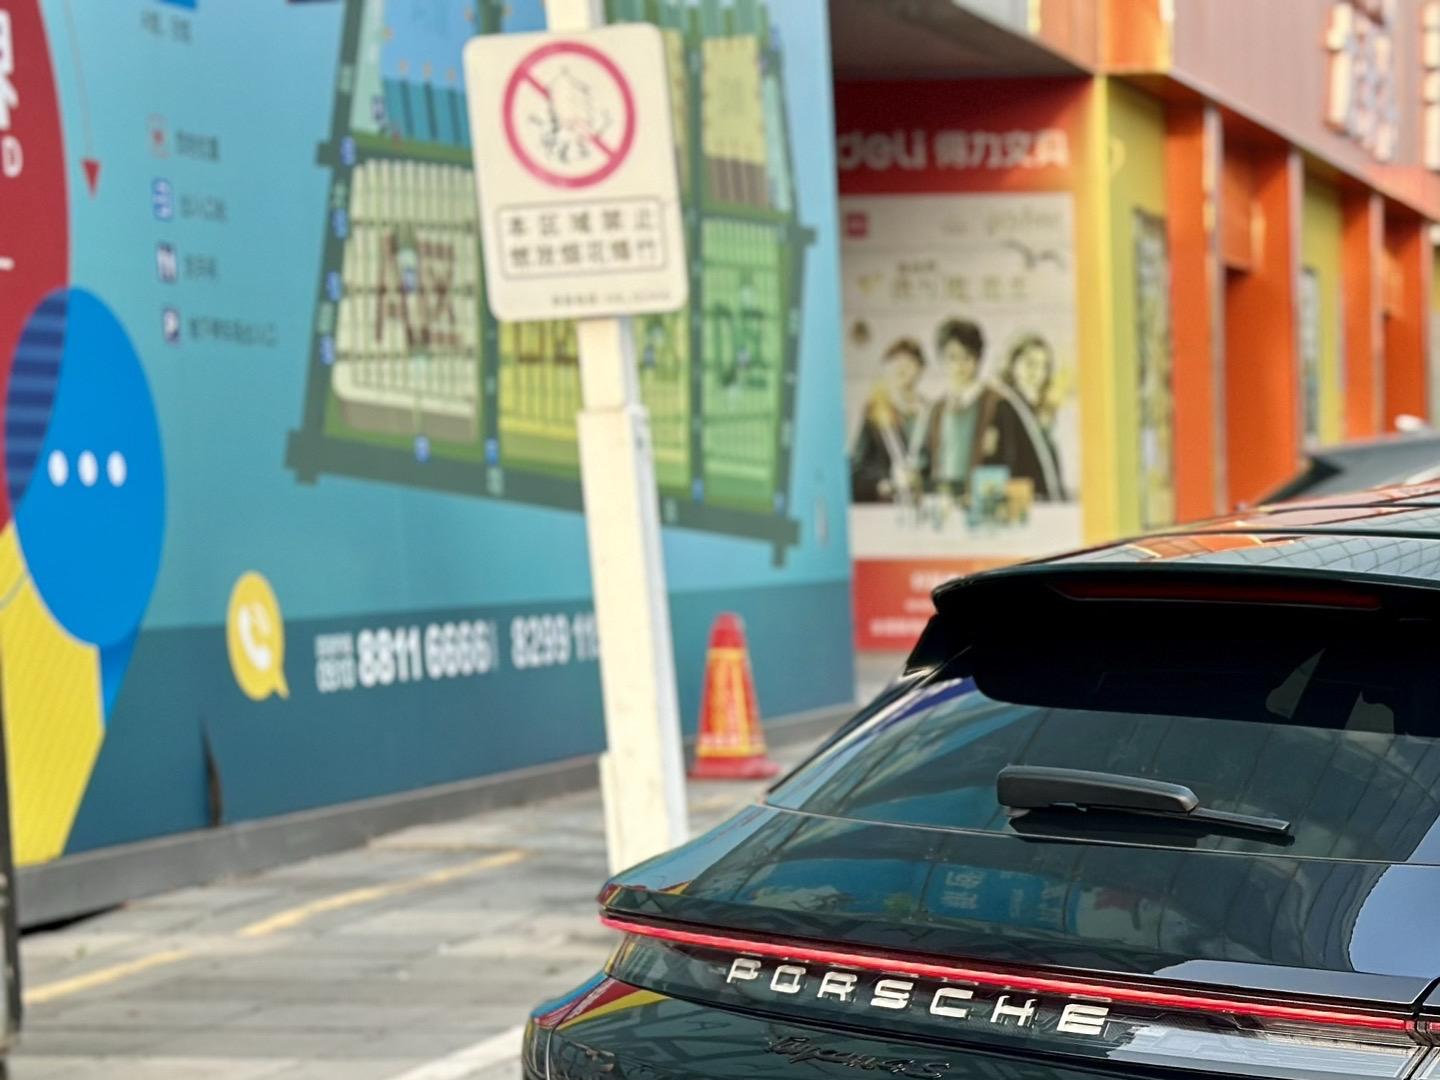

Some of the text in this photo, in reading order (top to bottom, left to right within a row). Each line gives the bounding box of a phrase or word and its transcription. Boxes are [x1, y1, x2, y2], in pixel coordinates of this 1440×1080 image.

[356, 626, 423, 689] 8811
[424, 619, 492, 680] 6666
[511, 612, 571, 670] 8299
[726, 957, 1110, 1036] PORSCHE
